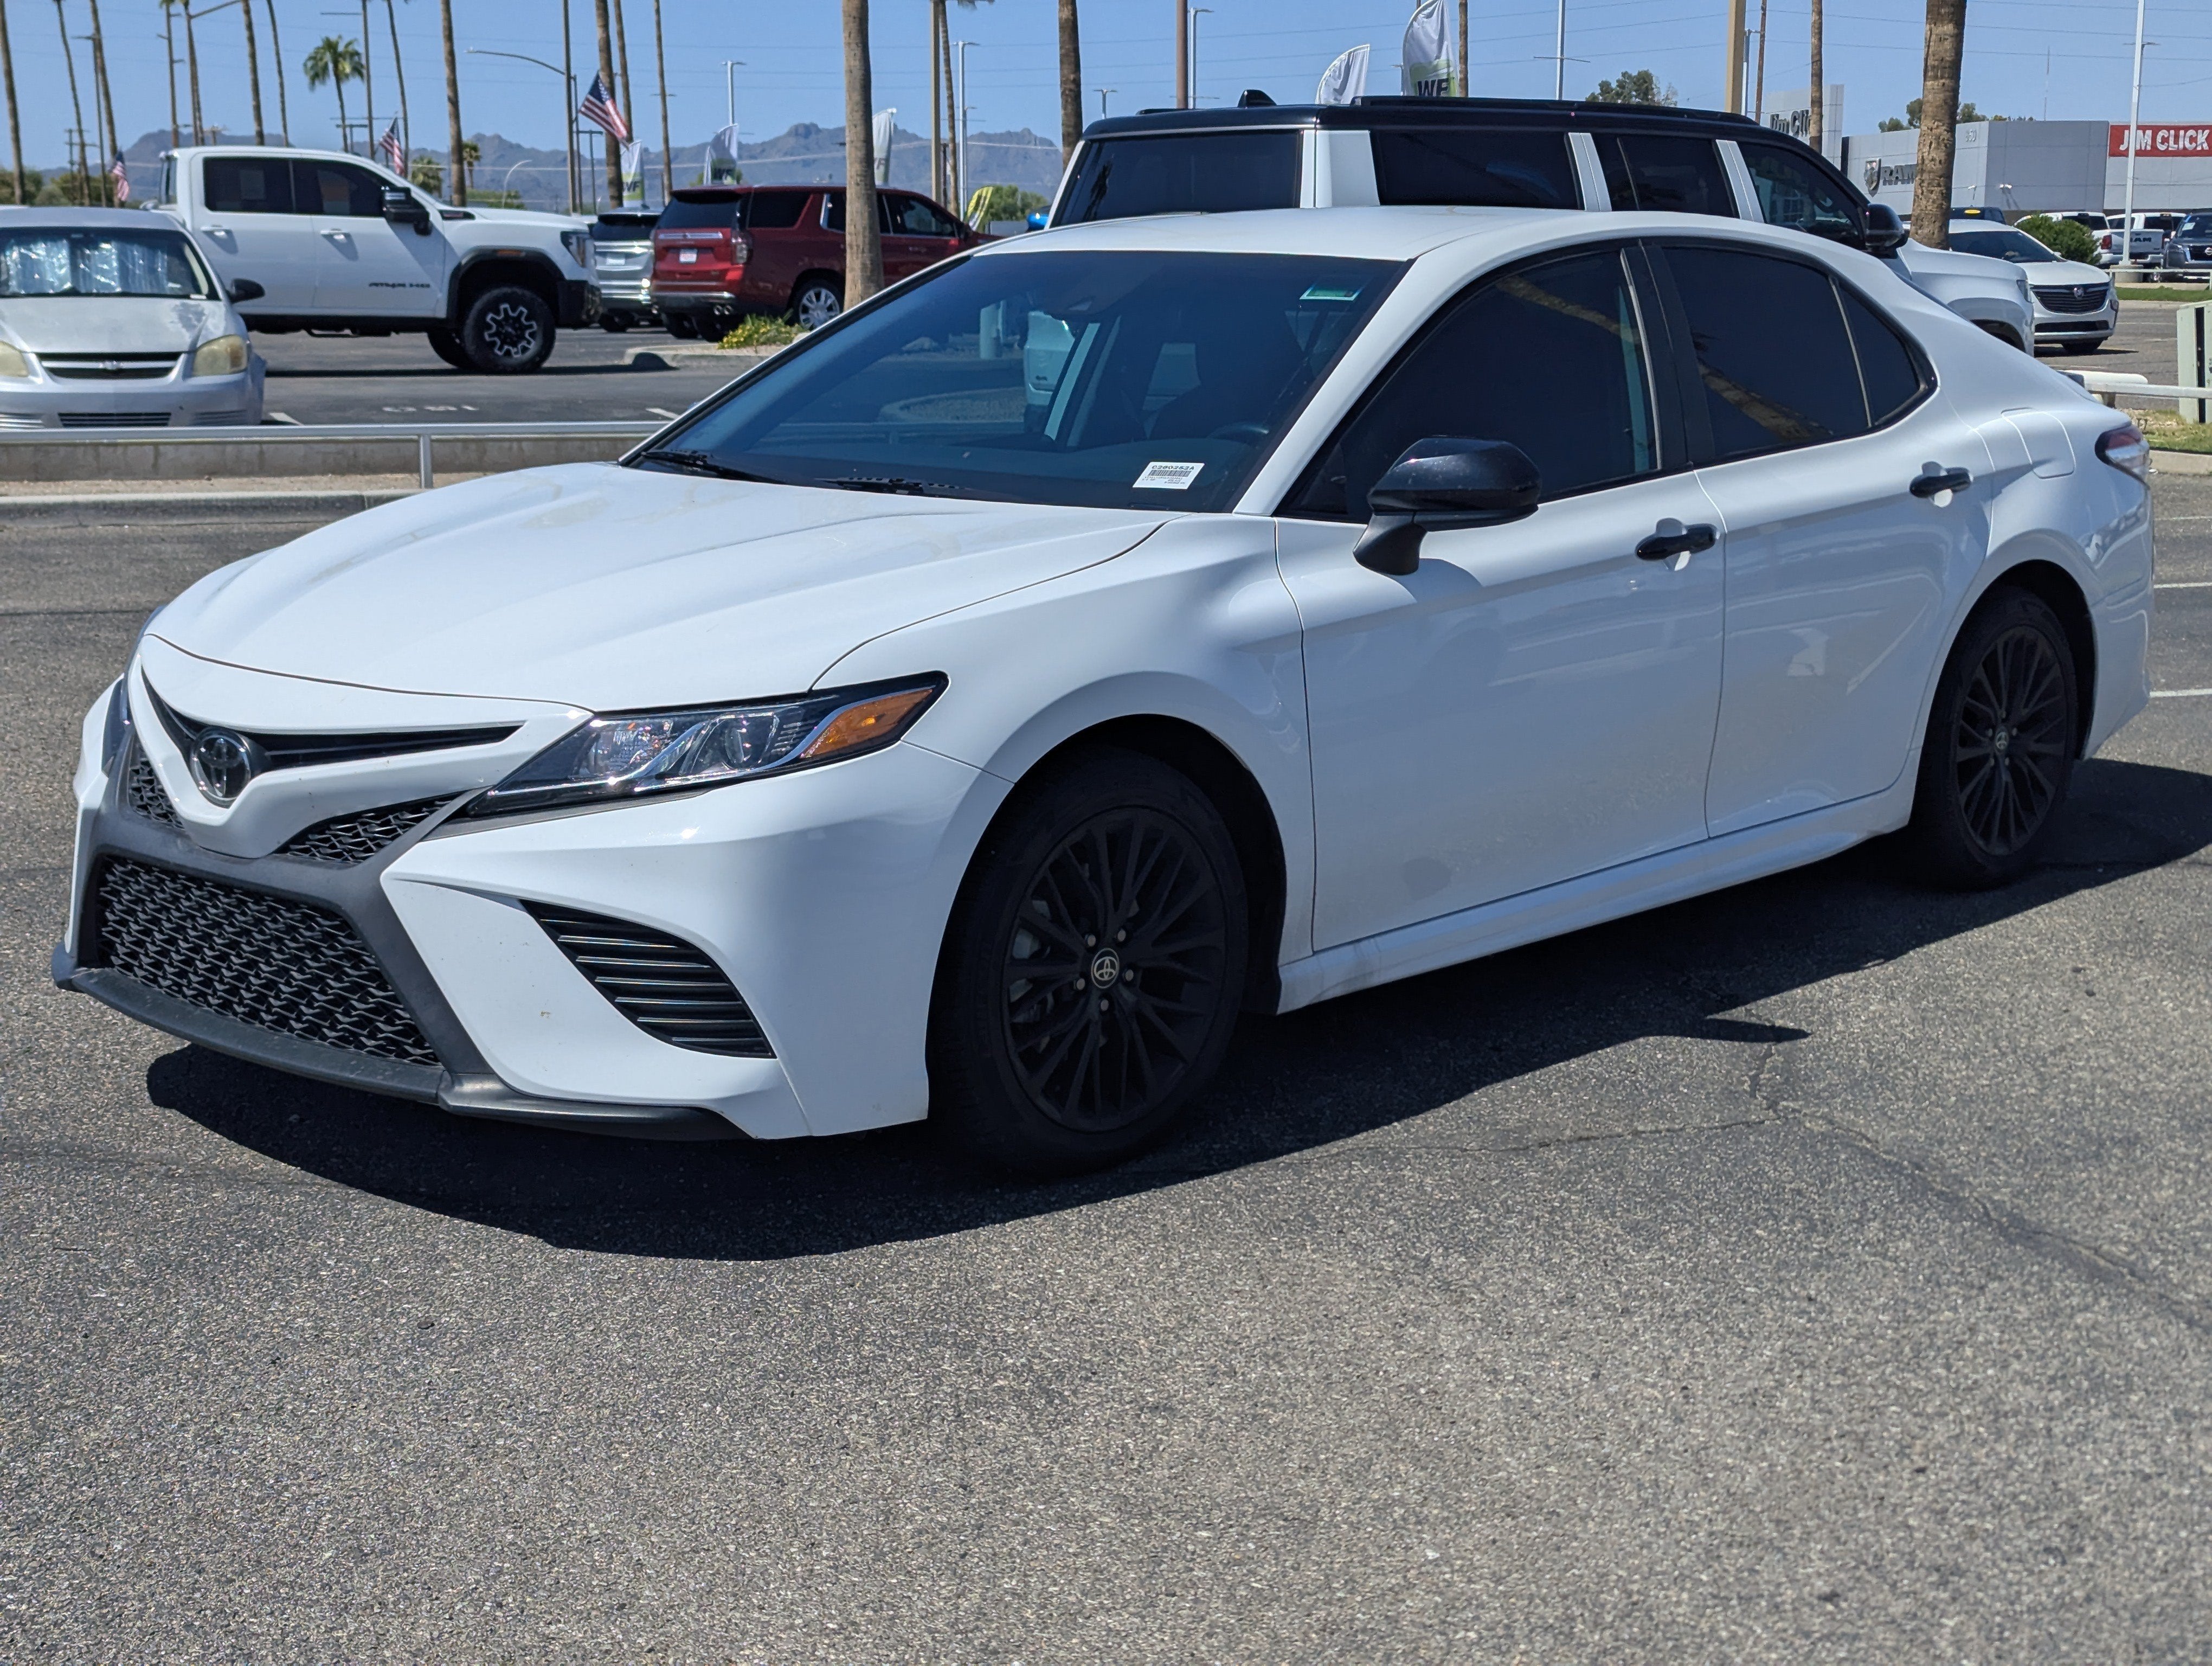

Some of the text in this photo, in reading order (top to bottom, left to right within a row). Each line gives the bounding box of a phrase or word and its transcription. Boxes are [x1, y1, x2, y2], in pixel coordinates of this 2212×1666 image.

[2119, 129, 2210, 151] JM CLICK
[1881, 164, 1918, 182] RAM
